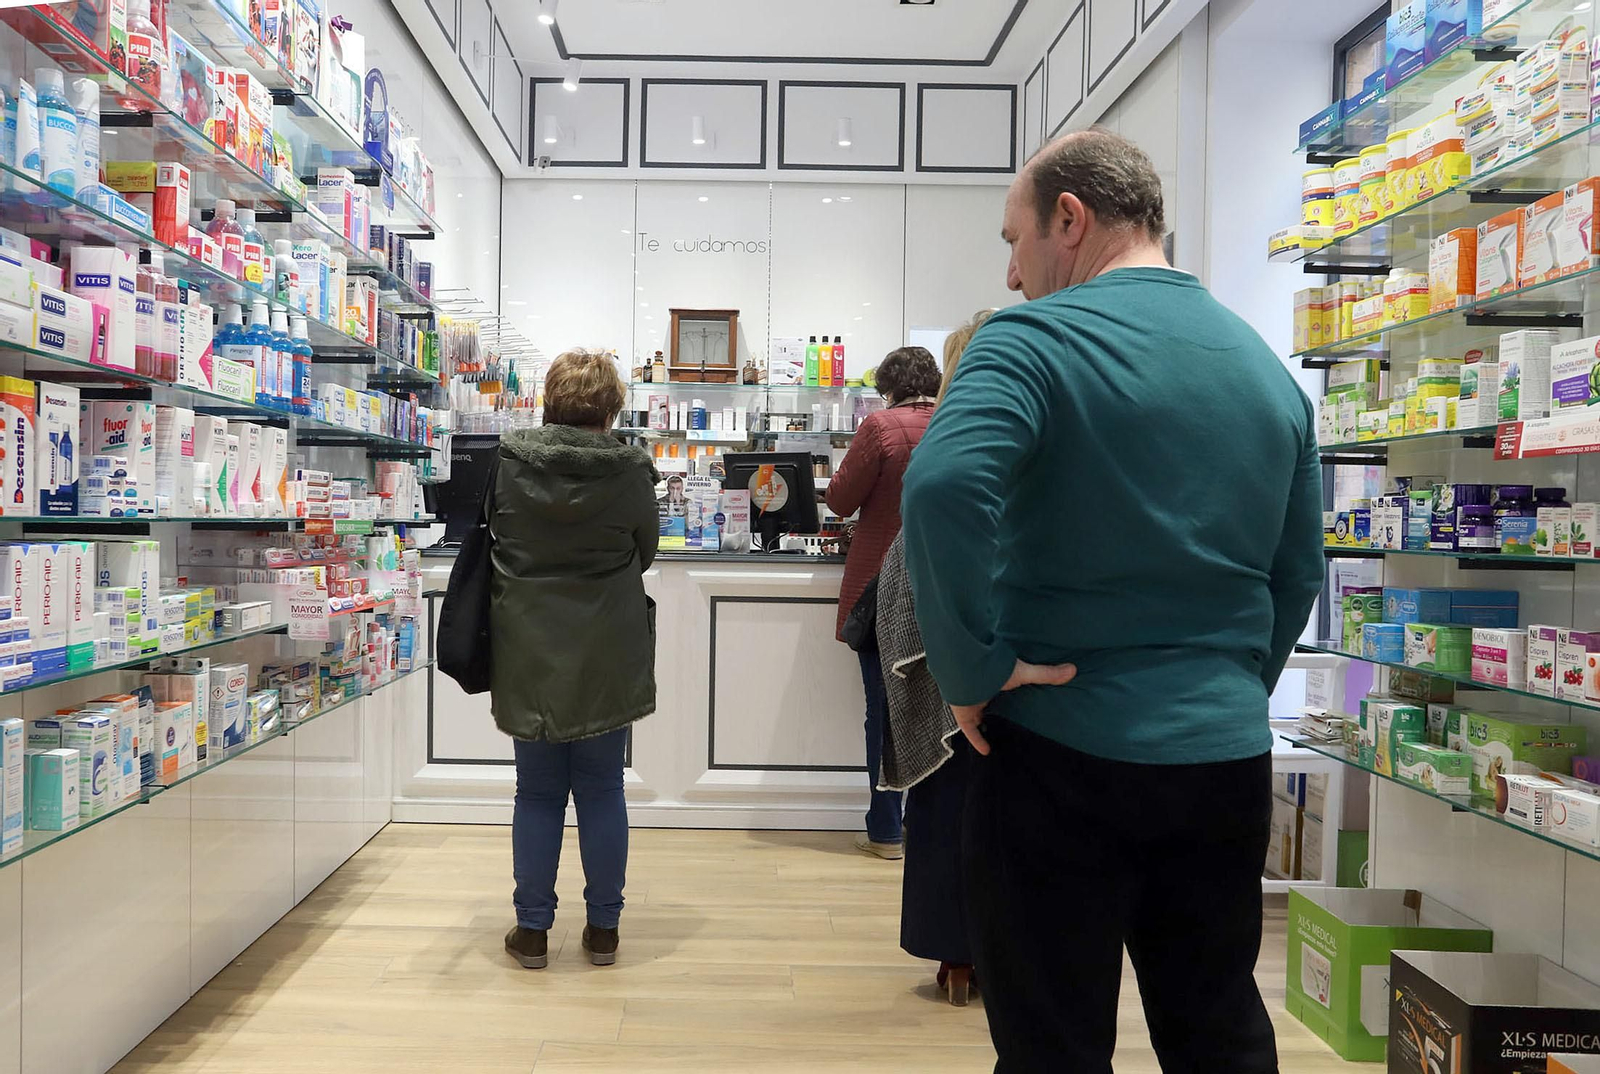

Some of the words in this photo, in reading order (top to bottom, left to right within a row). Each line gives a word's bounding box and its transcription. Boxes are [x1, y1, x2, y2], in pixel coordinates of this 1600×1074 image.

[130, 43, 149, 55] PHB
[319, 179, 343, 187] Lacer
[638, 232, 660, 252] Te
[673, 234, 767, 254] cuidamos
[291, 252, 318, 260] Lacer
[77, 276, 109, 285] VITIS
[119, 279, 134, 291] VITIS
[43, 297, 65, 313] VITIS
[41, 334, 64, 345] VITIS
[218, 360, 242, 374] Fluocaril
[217, 380, 241, 394] Fluocaril
[103, 418, 128, 432] fluor
[141, 420, 153, 434] fluor
[1501, 442, 1509, 450] 30
[14, 417, 25, 503] Desensin
[1502, 519, 1528, 528] Serenia
[291, 605, 323, 614] MAYOR
[1473, 631, 1505, 643] OENOBIOL
[1529, 646, 1549, 656] Cispren
[1558, 650, 1579, 661] Cispren
[1500, 1048, 1547, 1060] ¿Empieza
